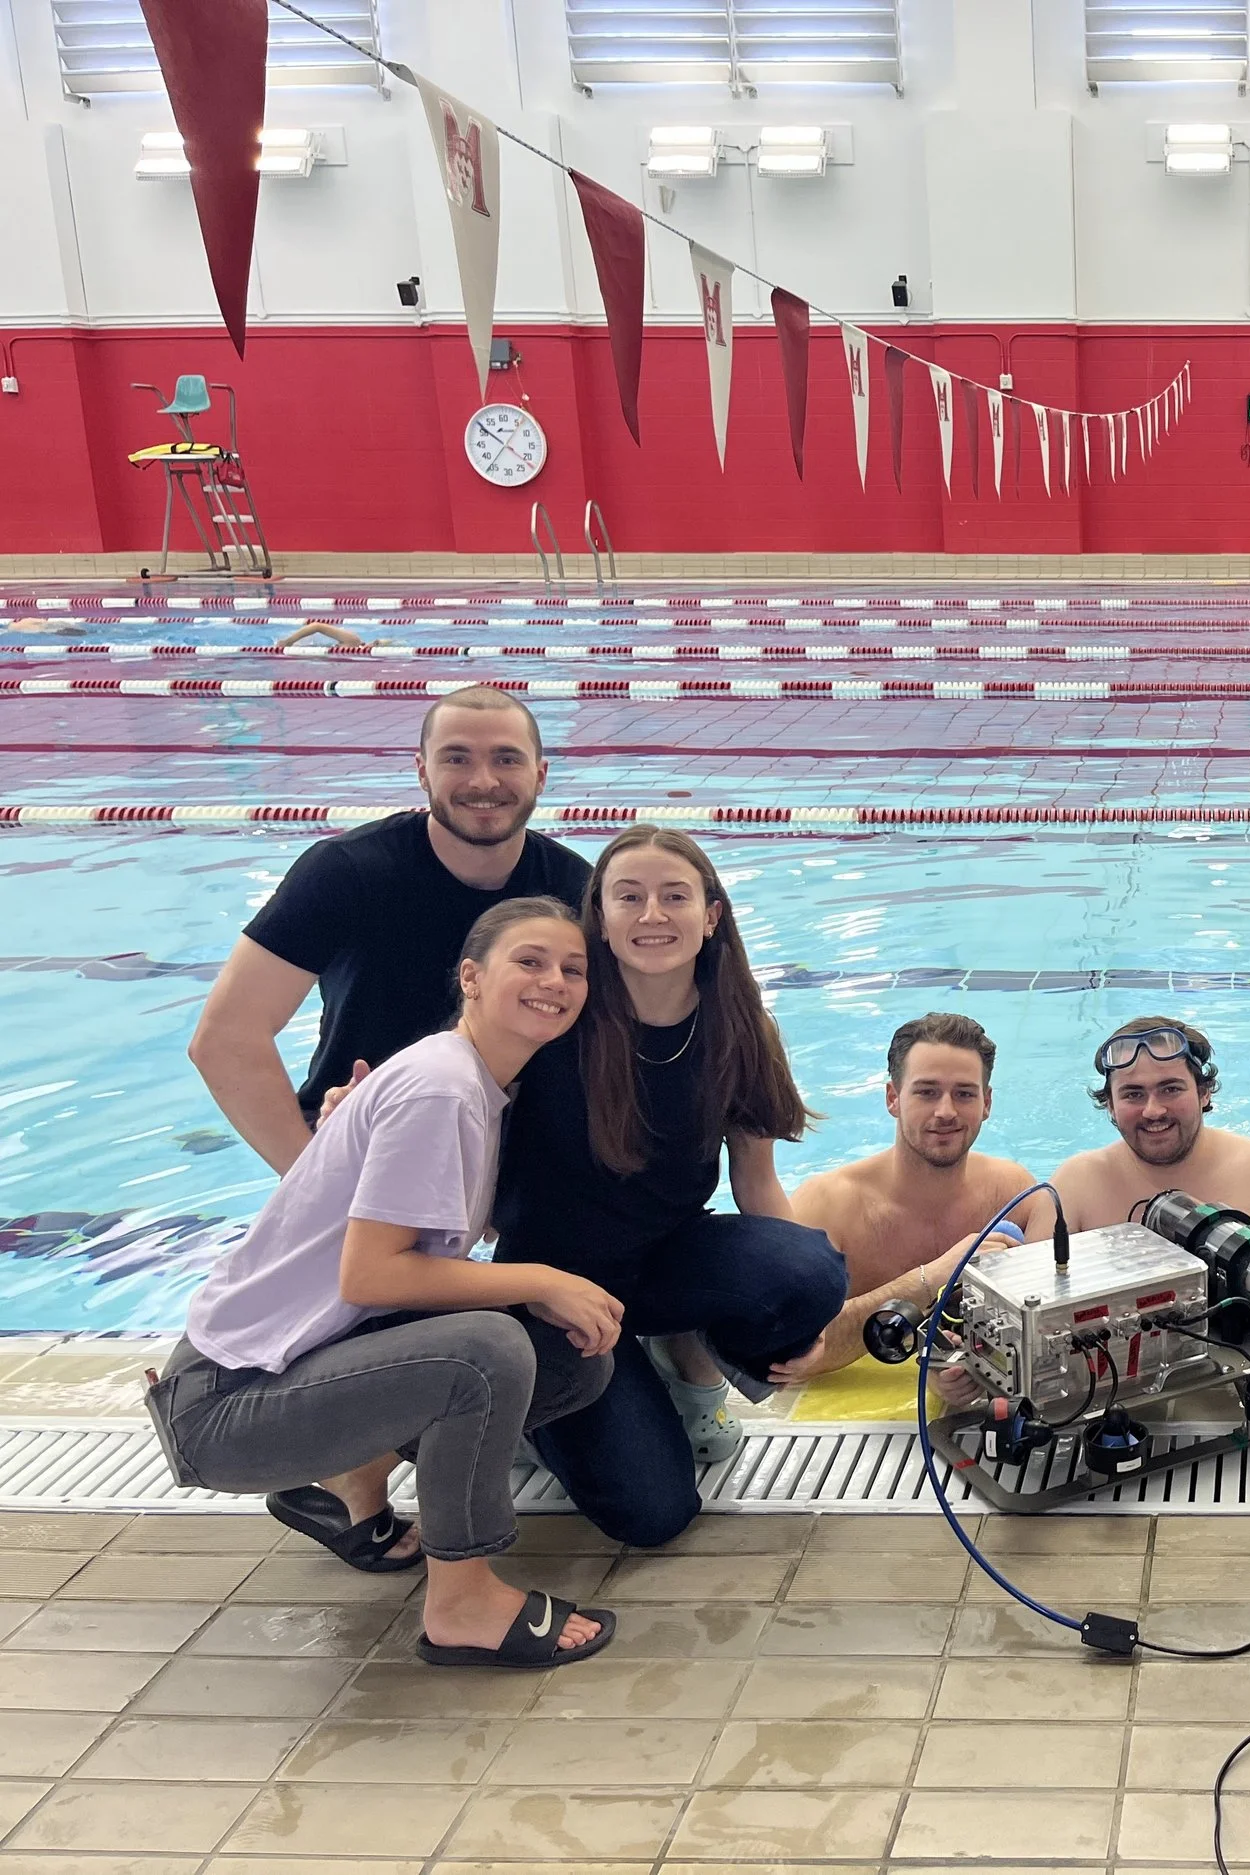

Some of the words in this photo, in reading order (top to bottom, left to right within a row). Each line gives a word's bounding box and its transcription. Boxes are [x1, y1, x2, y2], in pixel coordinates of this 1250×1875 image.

[486, 418, 496, 426] 55
[498, 414, 509, 422] 60
[514, 419, 520, 427] 5
[476, 441, 486, 449] 45
[528, 442, 536, 450] 15
[481, 452, 491, 460] 40
[523, 453, 532, 461] 20
[504, 468, 513, 476] 30
[516, 464, 525, 472] 25
